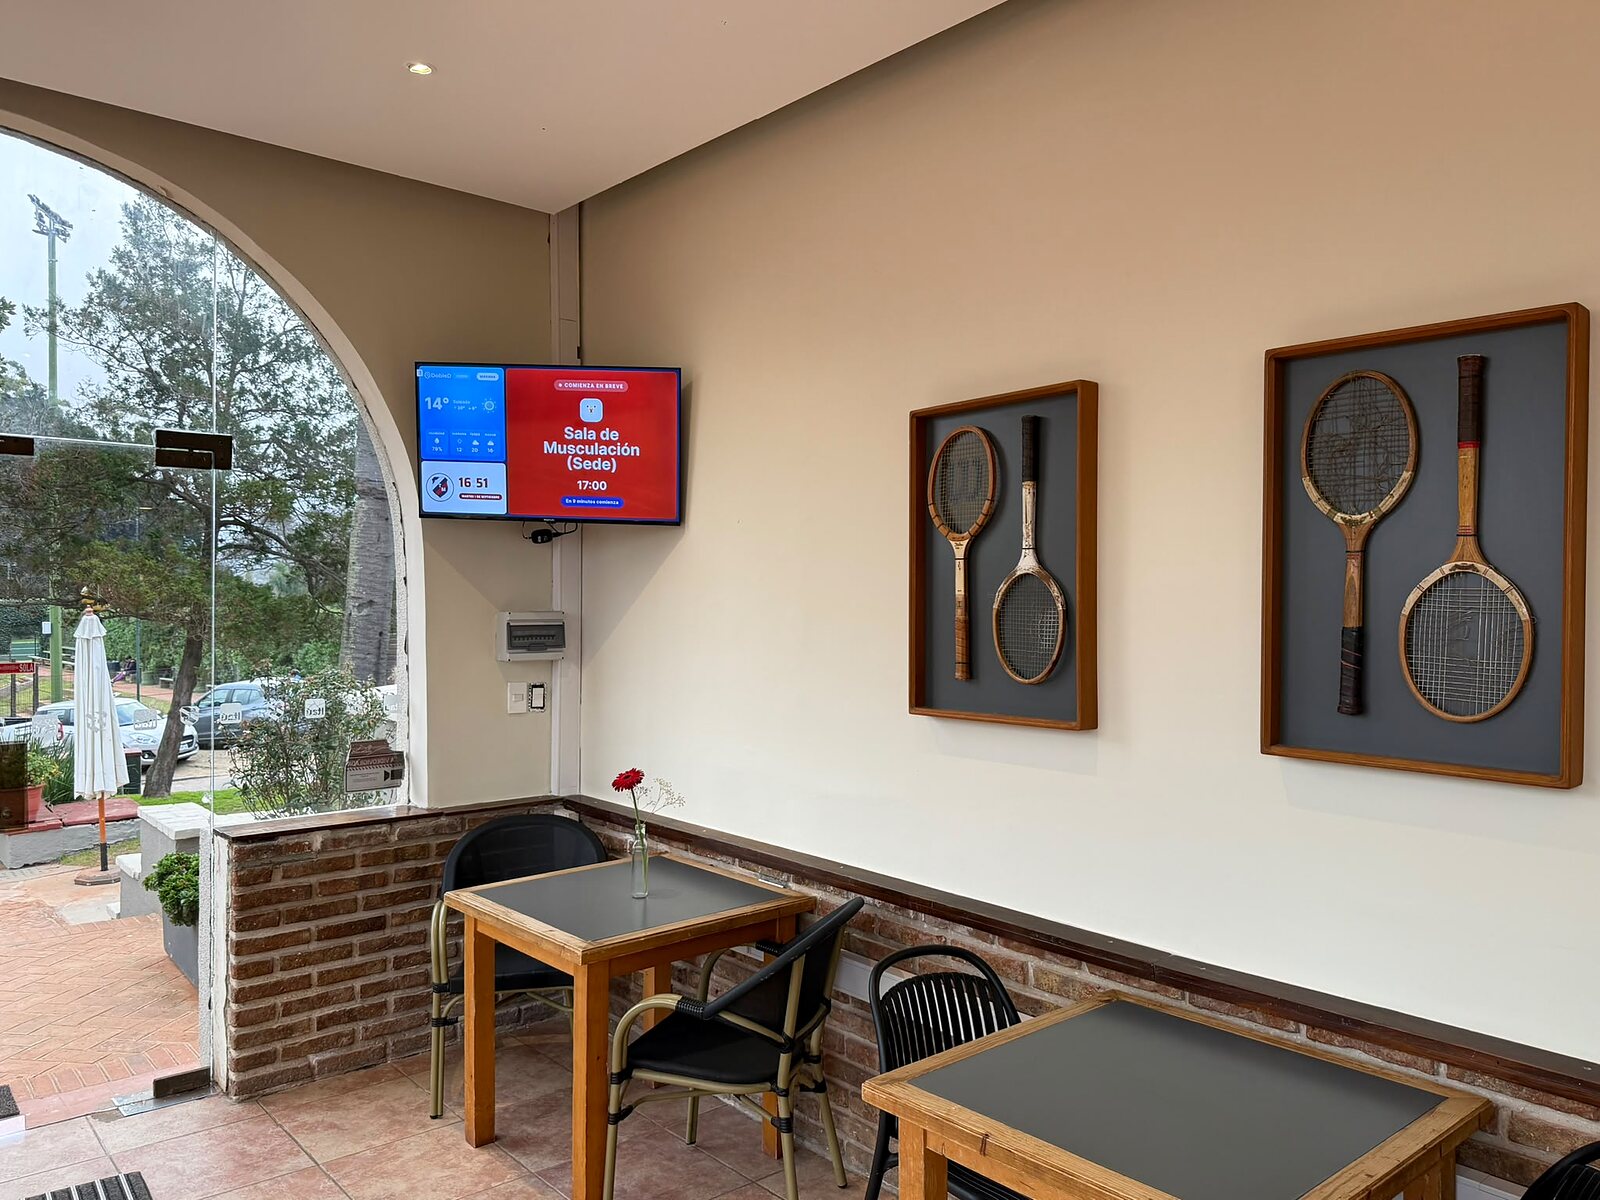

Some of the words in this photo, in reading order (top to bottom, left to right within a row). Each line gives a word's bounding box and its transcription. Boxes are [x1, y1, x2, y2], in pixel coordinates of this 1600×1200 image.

[564, 426, 596, 440] Sala
[600, 427, 619, 441] de
[543, 441, 640, 456] Musculación
[567, 455, 617, 473] (Sede)
[577, 480, 607, 491] 17:00
